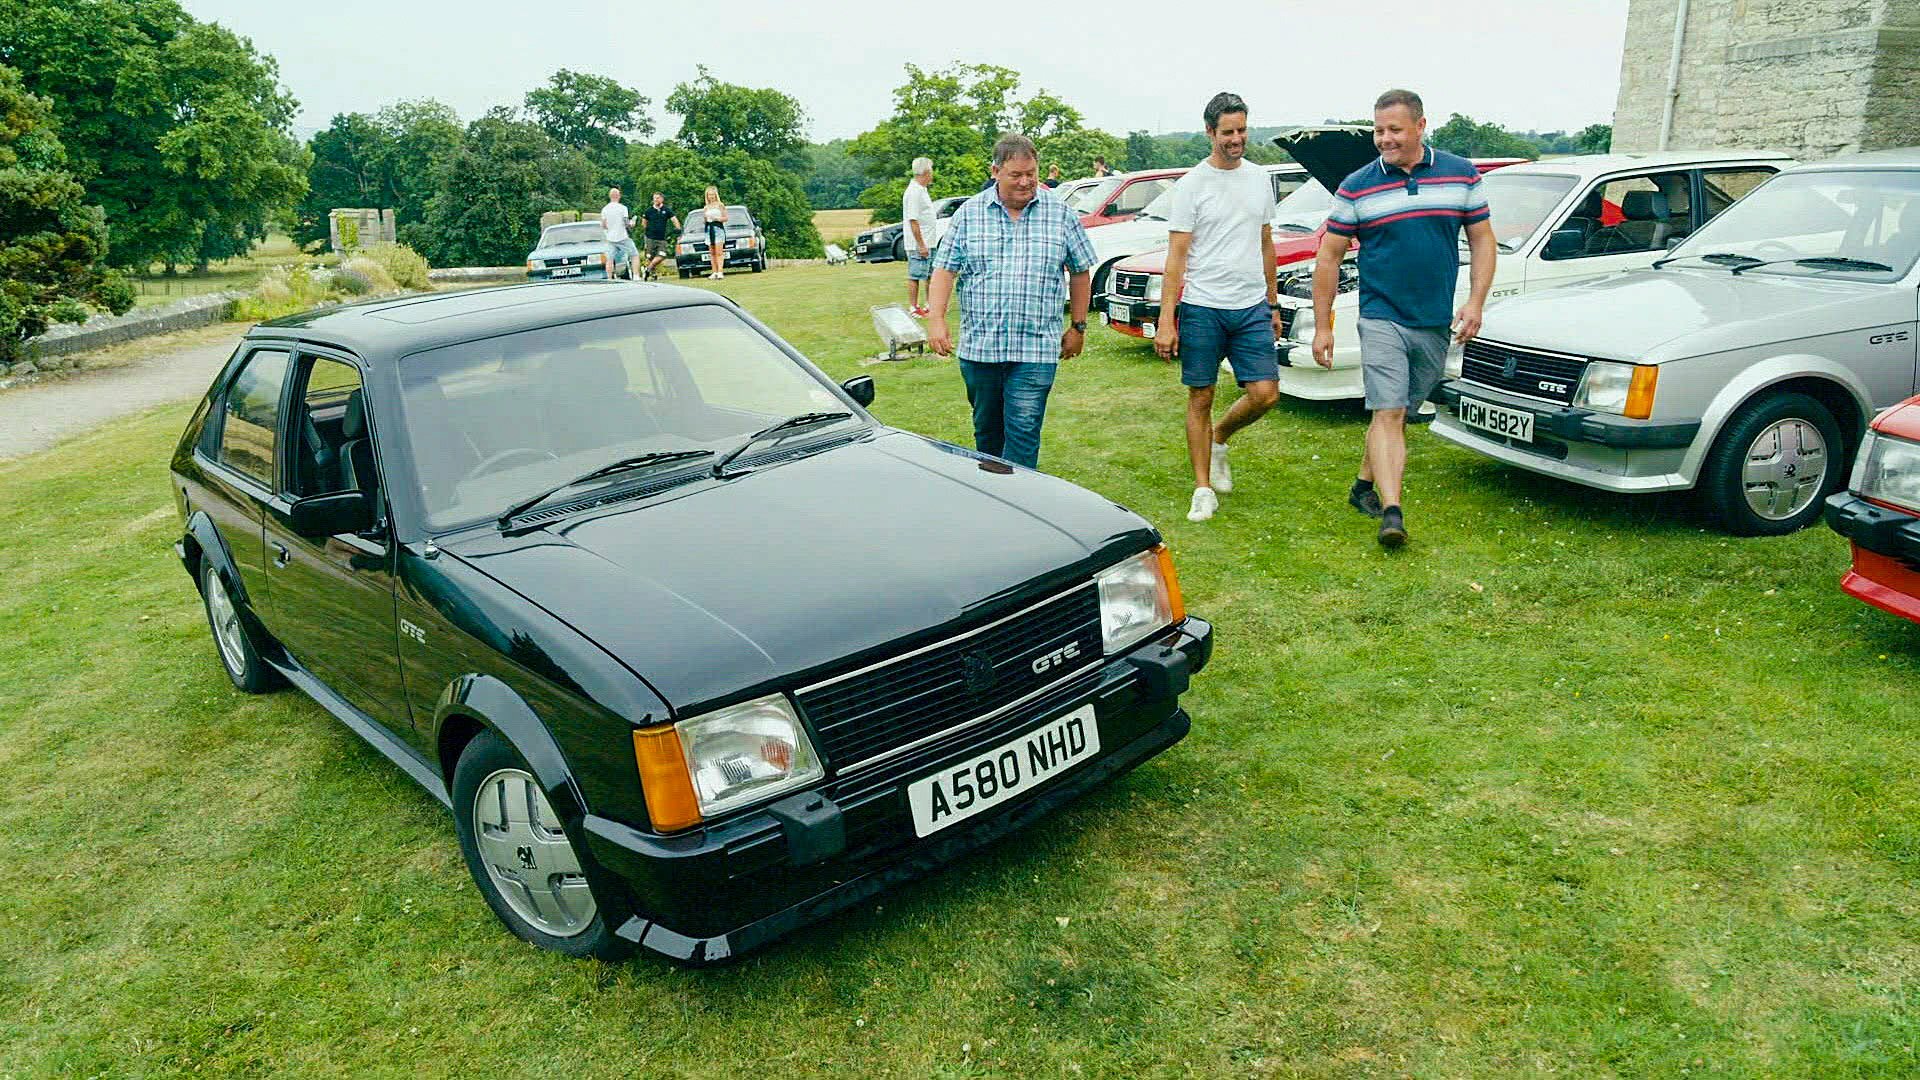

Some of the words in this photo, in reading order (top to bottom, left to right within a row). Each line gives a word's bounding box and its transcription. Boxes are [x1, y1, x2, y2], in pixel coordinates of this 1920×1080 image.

[1492, 288, 1519, 298] GTE
[1869, 331, 1909, 344] GTE
[1538, 380, 1568, 394] GTE
[1460, 400, 1487, 427] WGM
[1489, 410, 1530, 438] 582Y
[400, 618, 426, 644] GTE
[1031, 640, 1081, 674] GTE
[931, 749, 1020, 823] A580
[1027, 716, 1086, 777] NHD
